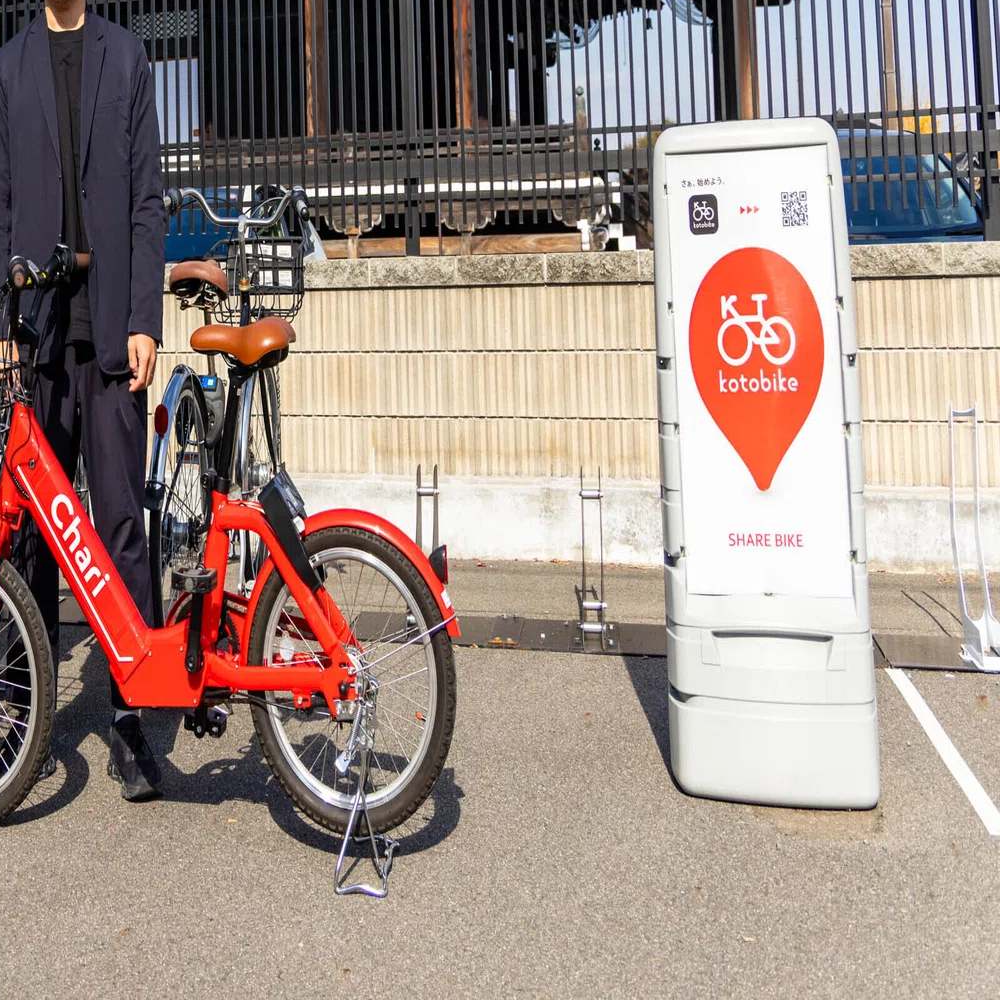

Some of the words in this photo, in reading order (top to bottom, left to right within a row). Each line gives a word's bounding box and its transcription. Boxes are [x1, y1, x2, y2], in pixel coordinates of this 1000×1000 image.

[693, 221, 715, 229] kotobike
[719, 368, 799, 393] kotobike
[51, 493, 110, 597] Chari
[728, 533, 771, 547] SHARE
[775, 533, 804, 547] BIKE
